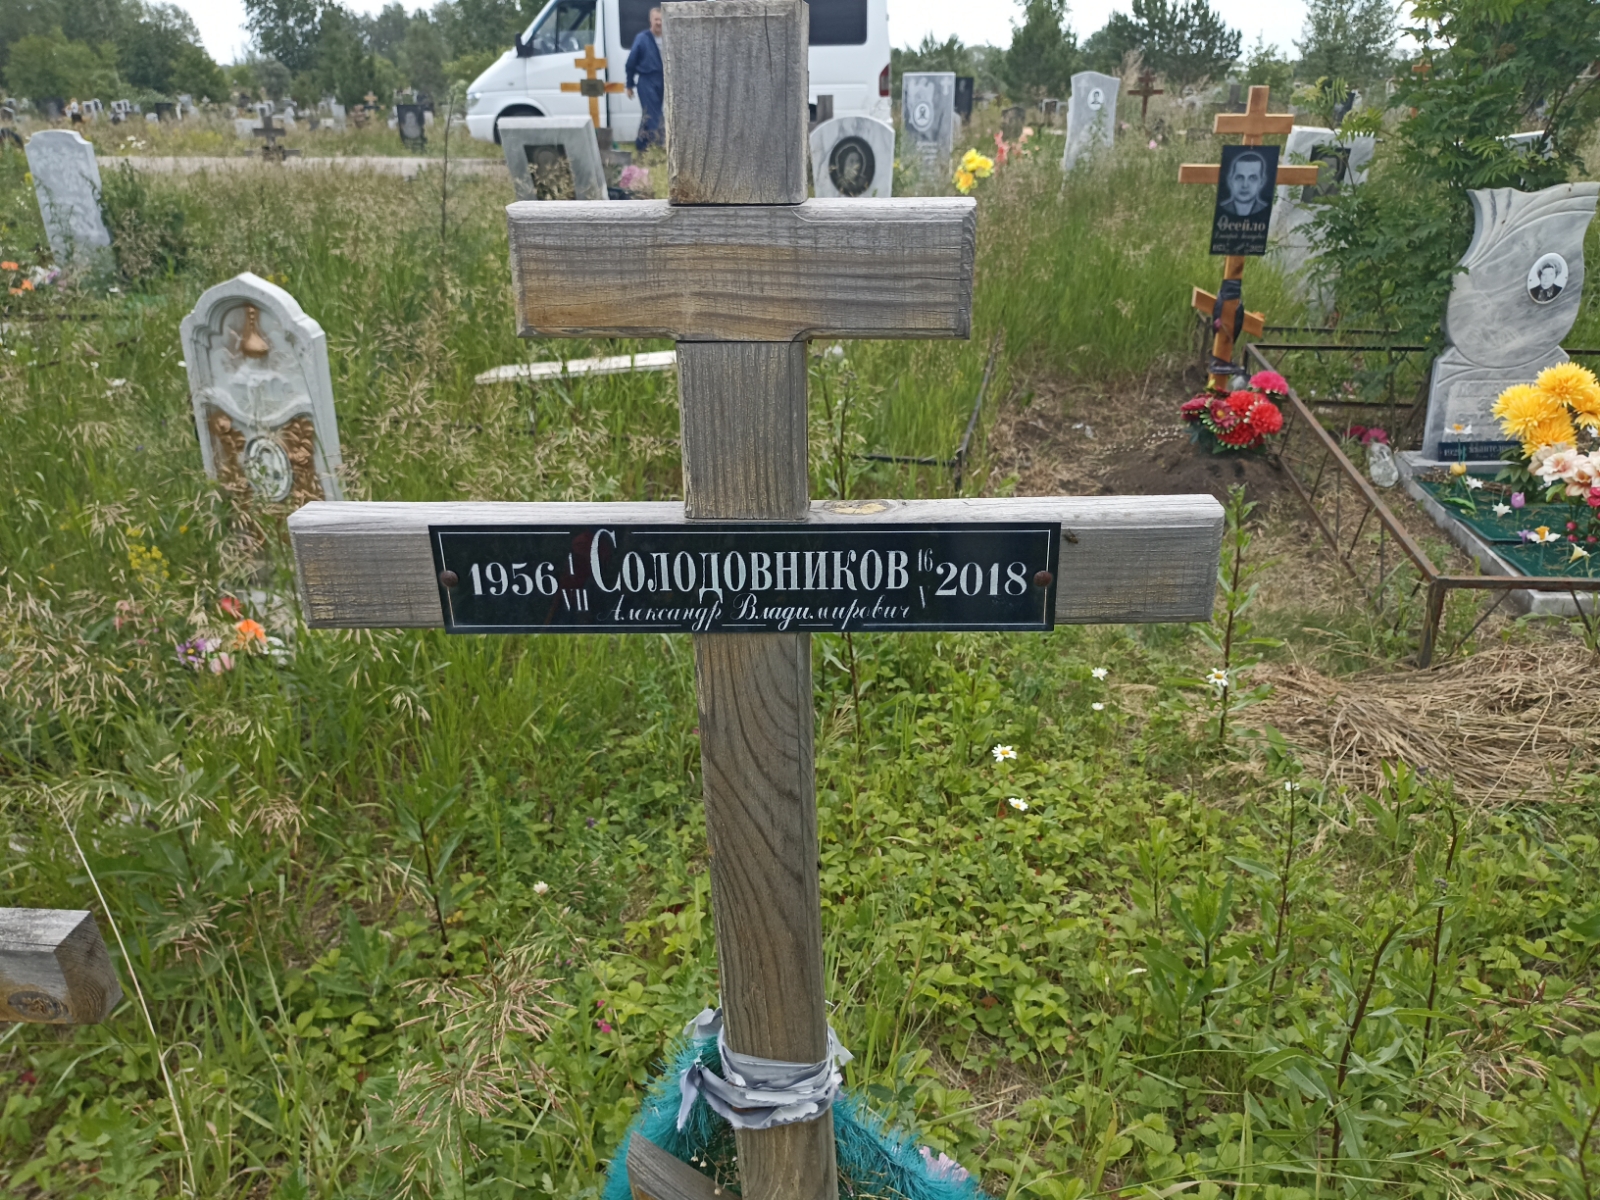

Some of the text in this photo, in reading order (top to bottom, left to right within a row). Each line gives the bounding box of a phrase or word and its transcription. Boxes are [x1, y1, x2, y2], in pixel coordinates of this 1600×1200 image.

[918, 547, 934, 573] 16
[468, 561, 559, 596] 1956
[935, 561, 1028, 596] 2018
[598, 592, 910, 631] Александр Владимирович
